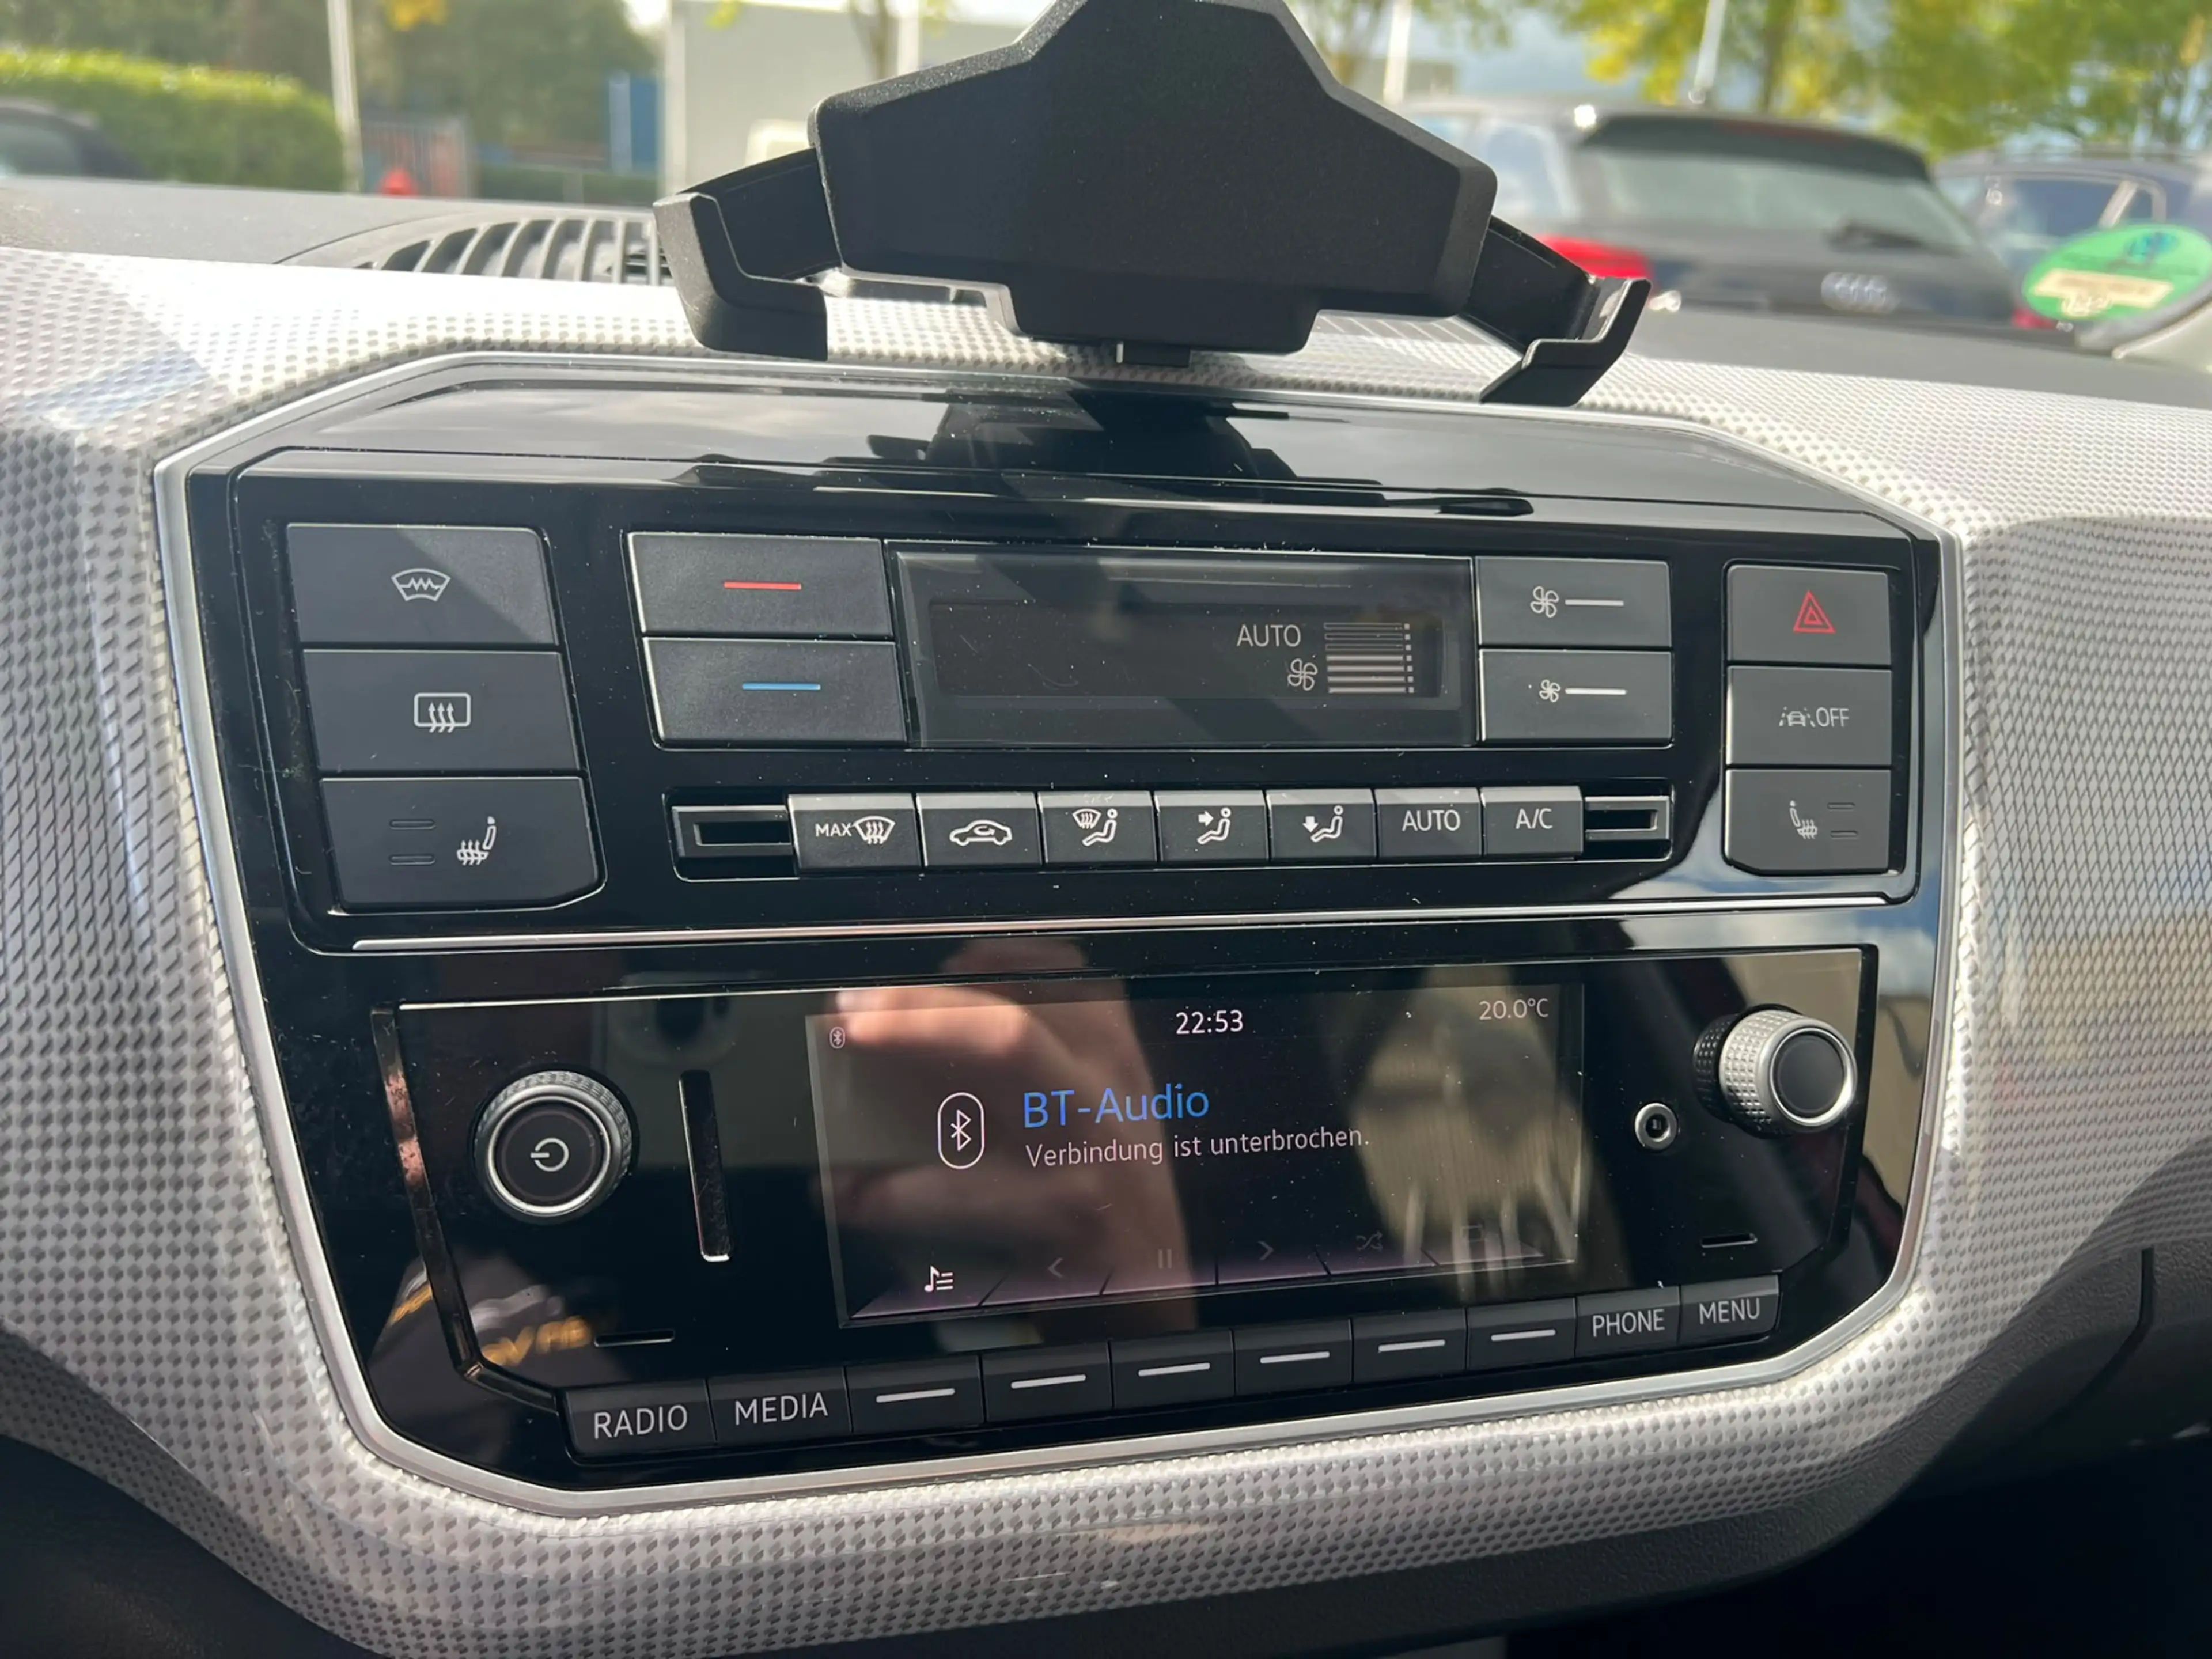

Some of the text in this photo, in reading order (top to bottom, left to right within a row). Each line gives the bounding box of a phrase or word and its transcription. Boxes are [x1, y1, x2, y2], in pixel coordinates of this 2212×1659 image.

[1237, 624, 1301, 647] AUTO
[1816, 708, 1850, 728] OFF
[816, 823, 853, 838] MAX
[1402, 810, 1461, 831] AUTO
[1516, 809, 1554, 830] A/C
[1479, 998, 1550, 1020] 20.0°C
[1175, 1010, 1244, 1035] 22:53
[1024, 1083, 1210, 1128] BT-Audio
[1025, 1139, 1163, 1168] Verbindung
[1174, 1135, 1202, 1158] ist
[1593, 1308, 1665, 1338] PHONE
[1699, 1297, 1760, 1324] MENU
[594, 1404, 688, 1439] RADIO
[734, 1392, 828, 1426] MEDIA
